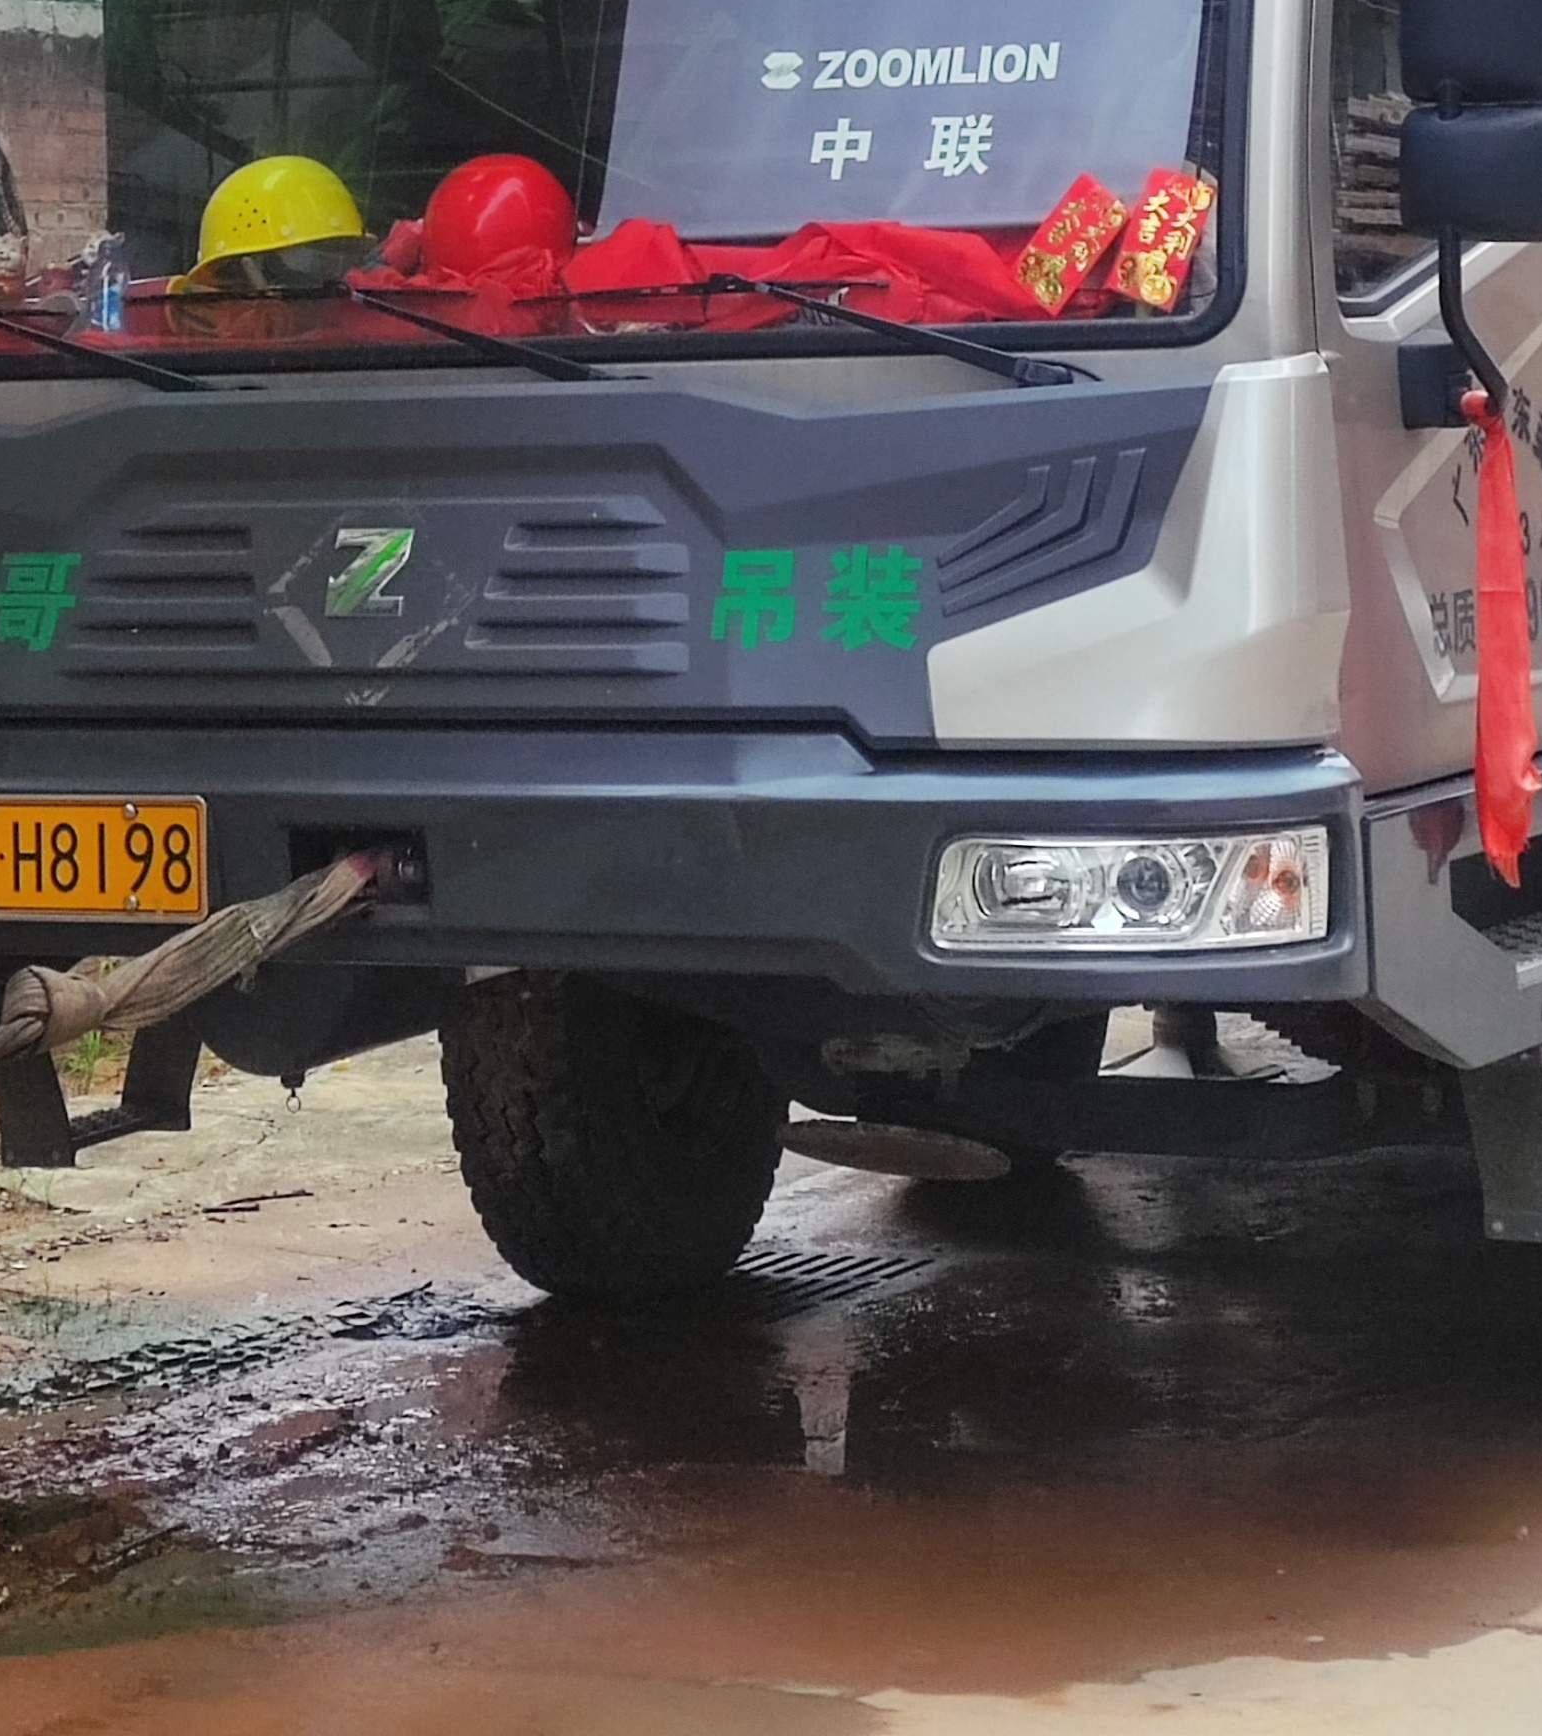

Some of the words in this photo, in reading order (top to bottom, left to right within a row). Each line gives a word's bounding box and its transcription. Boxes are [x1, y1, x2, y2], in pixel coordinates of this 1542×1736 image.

[813, 42, 1060, 90] ZOOMLION
[810, 114, 994, 181] 中联
[709, 544, 924, 653] 吊装
